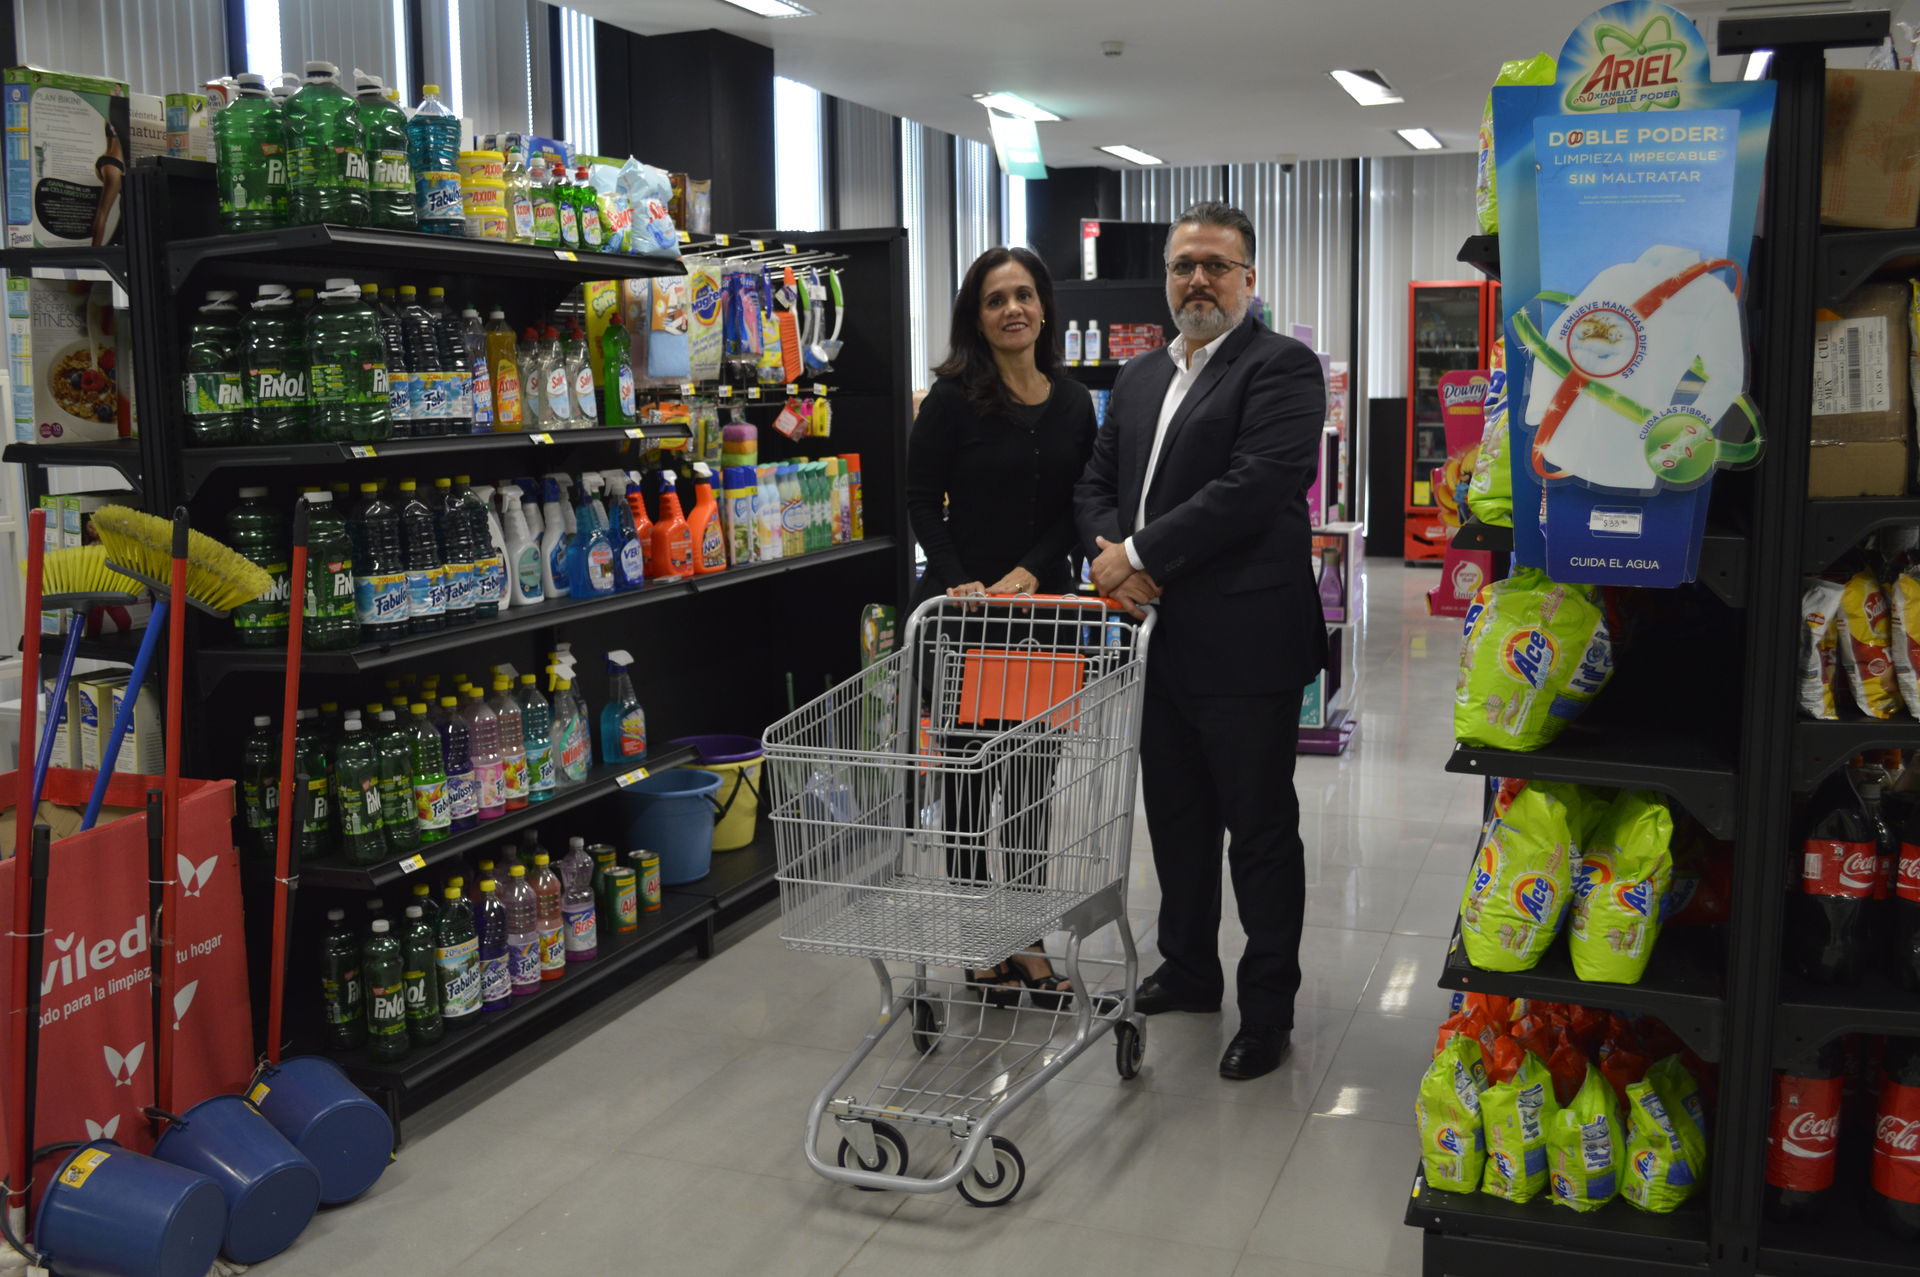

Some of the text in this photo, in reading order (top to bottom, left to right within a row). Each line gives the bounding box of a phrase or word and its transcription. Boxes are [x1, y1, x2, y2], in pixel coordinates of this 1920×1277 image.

[1580, 54, 1678, 95] ARIEL
[1554, 149, 1718, 165] LIMPIEZA IMPECABLE
[1569, 171, 1701, 185] SIN MALTRATAR
[472, 191, 497, 203] AXION
[35, 313, 80, 328] FITNESS
[1602, 301, 1645, 333] MANCHAS
[1444, 383, 1488, 402] Downy
[1640, 406, 1712, 440] CUIDA LAS FIBRAS
[1570, 557, 1660, 570] CUIDA EL AGUA
[1512, 629, 1548, 693] Ace
[1522, 877, 1550, 922] Ace
[176, 934, 222, 964] tu hogar
[64, 993, 91, 1019] para
[94, 986, 105, 1002] la
[1440, 1127, 1461, 1155] Ace
[1640, 1151, 1657, 1180] Ace
